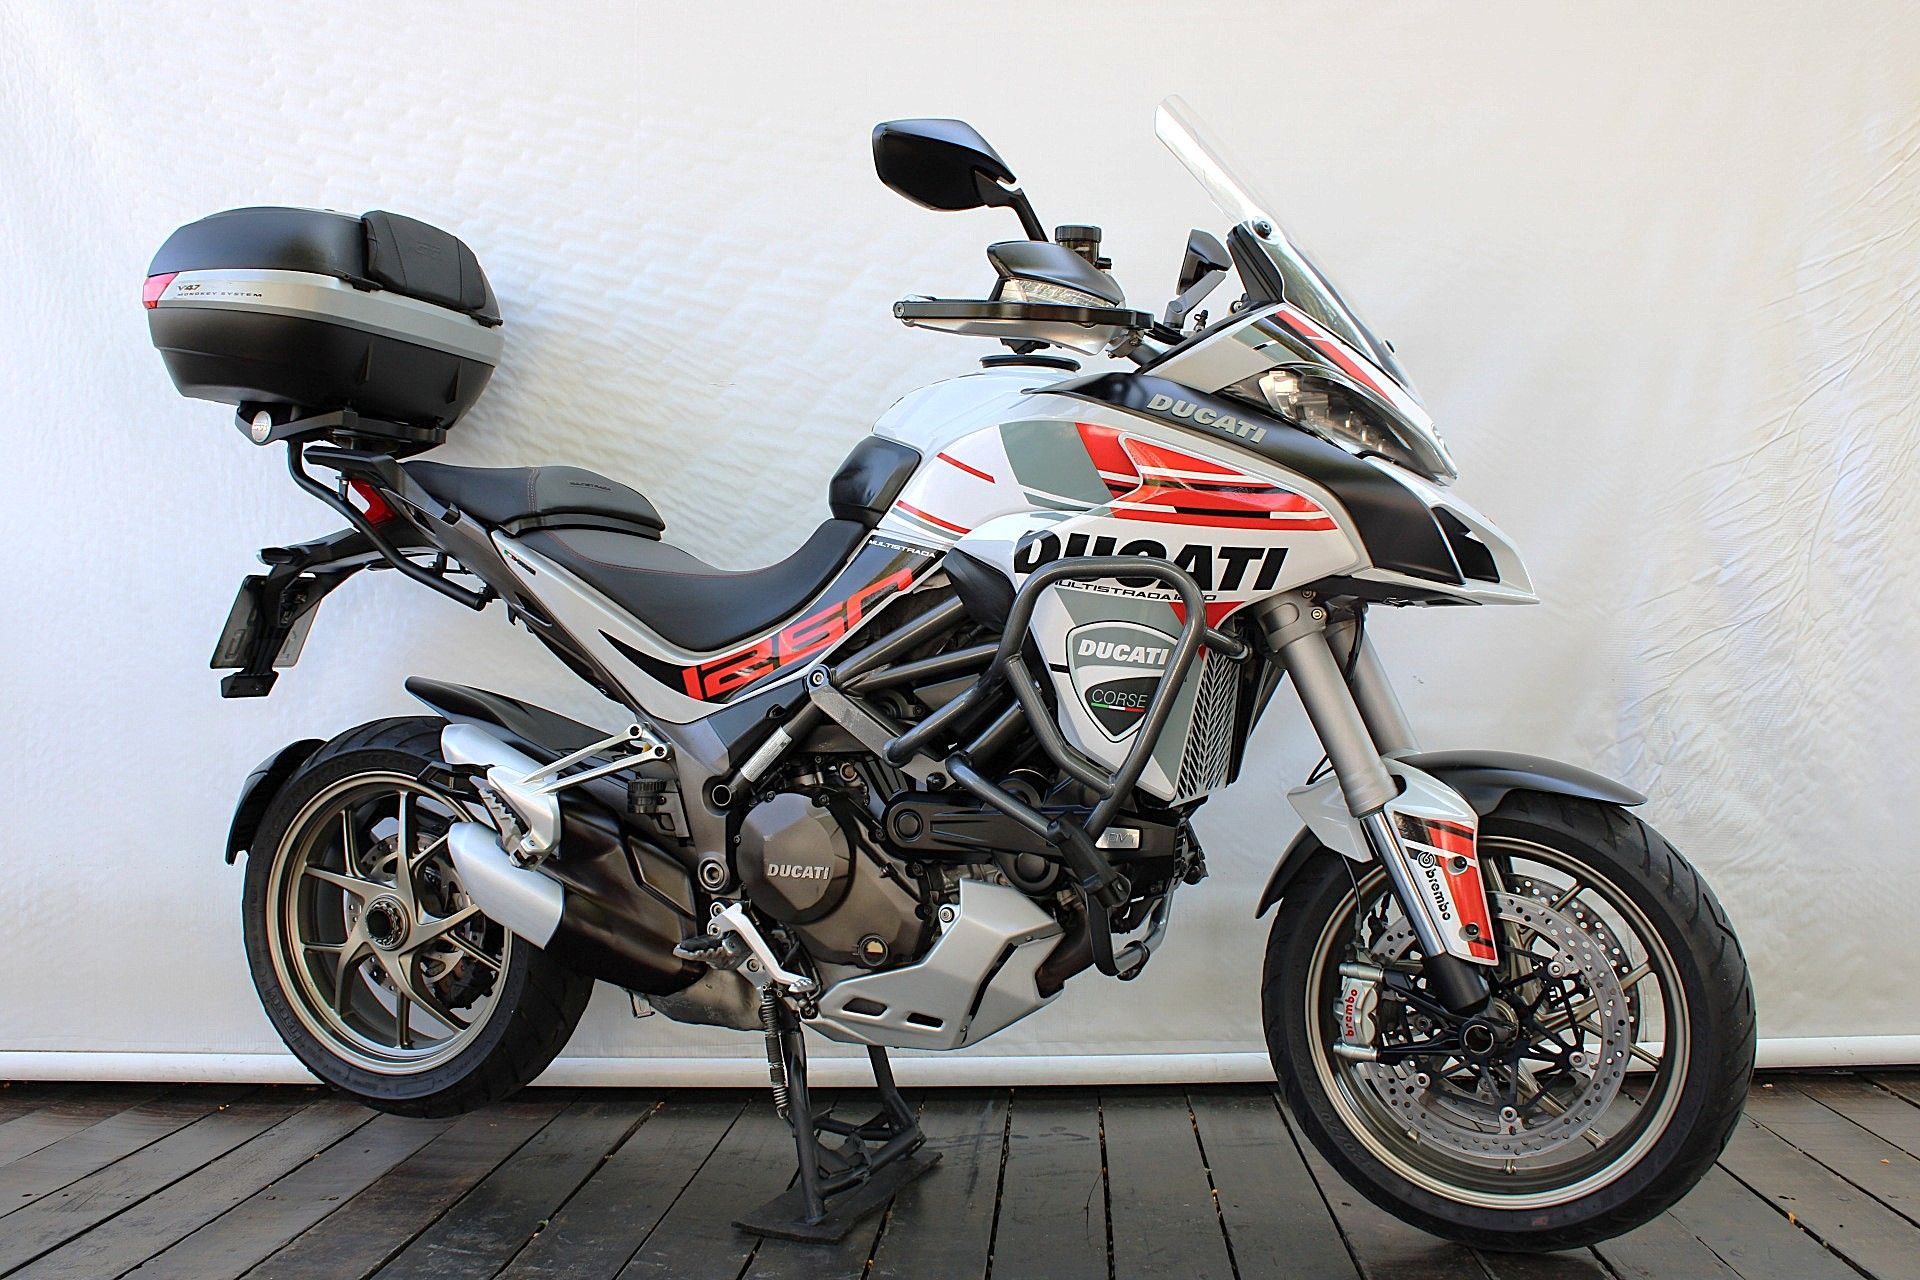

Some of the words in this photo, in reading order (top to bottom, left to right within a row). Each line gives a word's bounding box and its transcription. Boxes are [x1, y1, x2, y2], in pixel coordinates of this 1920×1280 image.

[177, 284, 201, 292] V47
[1146, 393, 1267, 444] DUCATI
[868, 539, 936, 559] MULTISTRADA
[1077, 639, 1170, 665] DUCATI
[1091, 688, 1149, 708] CORSE
[767, 863, 831, 880] DUCATI
[1425, 868, 1451, 921] brembo
[1344, 988, 1359, 1038] brembo
